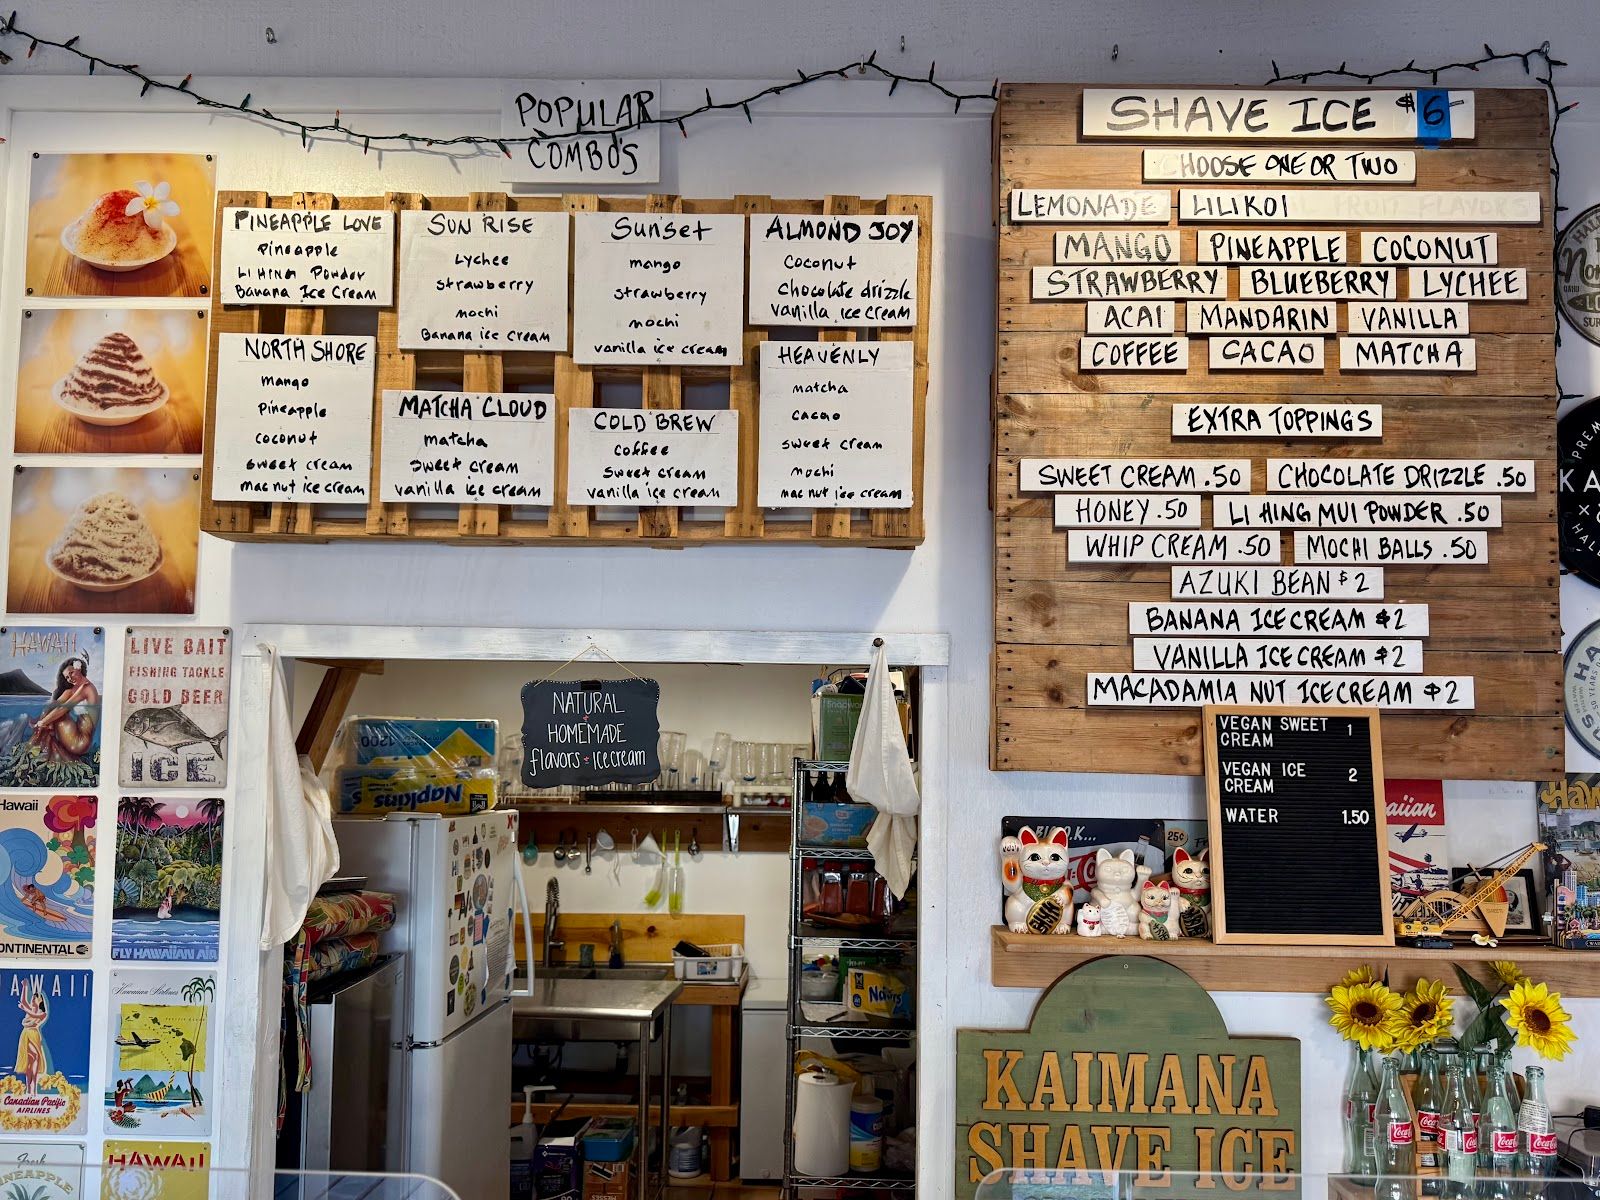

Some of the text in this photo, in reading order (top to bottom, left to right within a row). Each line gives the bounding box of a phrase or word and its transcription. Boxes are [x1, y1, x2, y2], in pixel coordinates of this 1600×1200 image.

[514, 91, 654, 129] POPULAR
[1106, 95, 1269, 132] SHAVE
[1288, 96, 1377, 132] ICE
[528, 137, 639, 175] COMBO'S
[1265, 152, 1304, 176] ONE
[1310, 153, 1338, 180] OR
[1348, 153, 1398, 179] TWO
[1017, 191, 1158, 217] LEMONADE
[1193, 195, 1288, 218] LILIKOI
[234, 211, 382, 233] PINEAPPLE LOVE
[426, 211, 535, 237] SUN RISE
[610, 215, 713, 242] Sunset
[765, 215, 915, 245] ALMOND JOY
[1063, 233, 1173, 261] MANGO
[1209, 233, 1341, 264] PINEAPPLE
[1372, 235, 1491, 266] COCONUT
[629, 260, 681, 274] mango
[234, 284, 377, 300] Banana Ice Cream
[436, 277, 534, 295] strawberry
[613, 287, 707, 306] strawberry
[1047, 268, 1218, 299] STRAWBERRY
[1251, 269, 1389, 299] BLUEBERRY
[1421, 270, 1522, 301] LYCHEE
[455, 305, 498, 319] mochi
[628, 314, 679, 329] mochi
[1103, 305, 1162, 330] ACAI
[1200, 304, 1329, 332] MANDARIN
[1361, 307, 1458, 332] VANILLA
[420, 327, 550, 343] Banana ice cream
[245, 338, 368, 366] NORTH SHORE
[777, 346, 881, 367] HEAVENLY
[1092, 341, 1178, 368] COFFEE
[1222, 340, 1315, 366] CACAO
[1356, 341, 1463, 368] MATCHA
[792, 381, 849, 394] matcha
[398, 394, 547, 421] MATCHA CLOUD
[791, 410, 841, 422] cacao
[1187, 406, 1373, 435] EXTRA TOPPINGS
[593, 411, 716, 433] COLD BREW
[255, 431, 318, 445] coconut
[423, 432, 488, 448] matcha
[613, 441, 669, 457] coffee
[781, 438, 883, 451] sweet cream
[657, 467, 706, 480] cream
[790, 464, 834, 479] mochi
[1038, 464, 1241, 489] SWEET CREAM .50
[1278, 462, 1527, 489] CHOCOLATE DRIZZLE .50
[1075, 498, 1188, 526] HONEY .50
[1228, 501, 1490, 527] LI HING MUI POWDER .50
[1086, 534, 1271, 561] WHIP CREAM .50
[1307, 535, 1477, 562] MOCHI BALLS .50
[1572, 523, 1600, 557] HAL
[1179, 570, 1258, 597] AZUKI
[1271, 569, 1330, 597] BEAN
[1145, 607, 1241, 633] BANANA
[12, 632, 77, 658] HAWAII
[130, 638, 227, 655] LIVE BAIT
[1151, 643, 1249, 672] VANILLA
[129, 666, 225, 678] FISHING TACKLE
[181, 688, 223, 705] BEER
[1092, 674, 1286, 704] MACADAMIA NUT
[551, 690, 627, 716] NATURAL
[546, 722, 628, 745] HOMEMADE
[1220, 715, 1353, 737] VEGAN SWEET 1
[1220, 732, 1274, 748] CREAM
[131, 752, 216, 782] ICE
[529, 748, 581, 777] flavors
[1222, 761, 1358, 782] VEGAN ICE 2
[374, 783, 463, 811] Napkins
[1224, 778, 1274, 794] CREAM
[1225, 808, 1370, 825] WATER 1.50
[1036, 825, 1056, 839] BI
[112, 948, 132, 959] FLY
[0, 974, 88, 997] AWAII
[981, 1050, 1278, 1116] KAIMANA
[3, 1096, 66, 1109] Canadian Pacific
[108, 1151, 204, 1171] HAWAII
[967, 1123, 1295, 1192] SHAVE ICE
